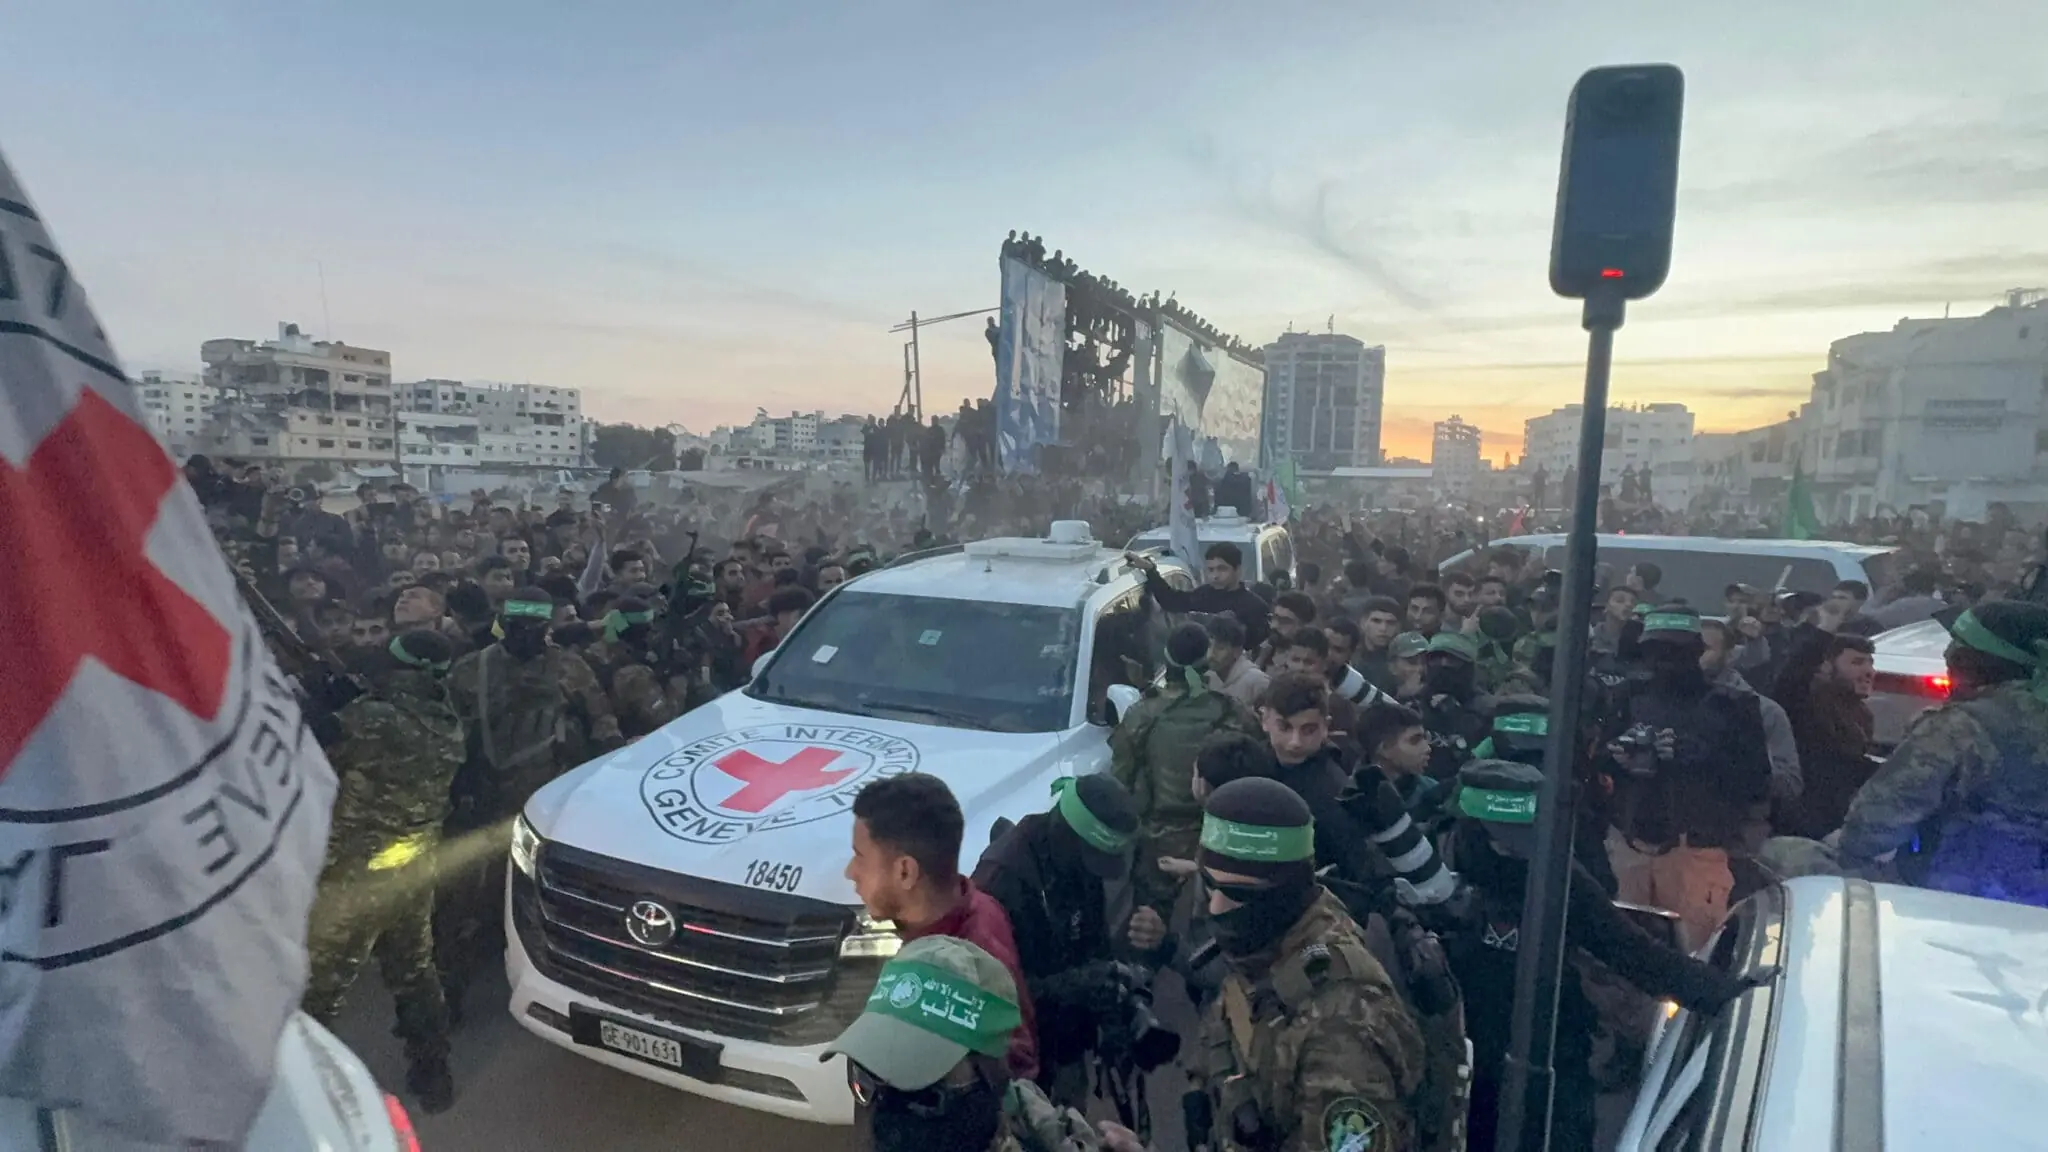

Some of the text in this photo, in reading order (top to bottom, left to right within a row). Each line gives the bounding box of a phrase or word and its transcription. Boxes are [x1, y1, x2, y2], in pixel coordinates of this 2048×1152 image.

[653, 730, 760, 782] COMITE
[653, 788, 797, 840] GENEVE
[744, 859, 803, 892] 18450
